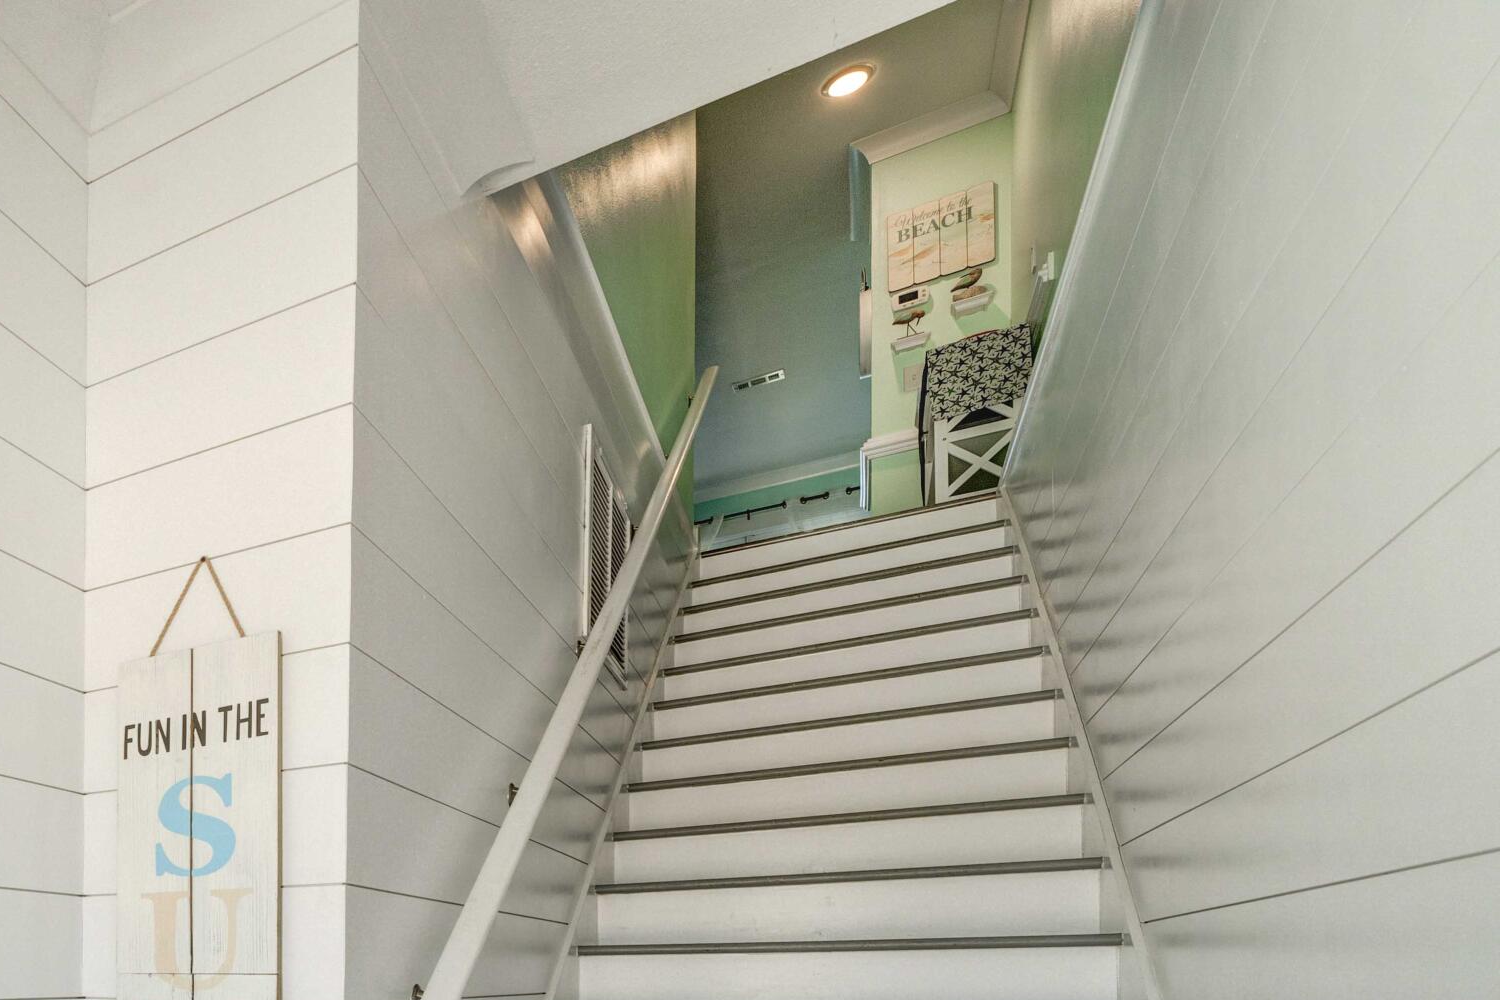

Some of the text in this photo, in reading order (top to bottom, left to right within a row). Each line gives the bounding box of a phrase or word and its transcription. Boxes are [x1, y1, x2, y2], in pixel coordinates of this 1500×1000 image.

[947, 200, 956, 212] to
[959, 194, 973, 209] the
[897, 205, 973, 243] BEACH
[123, 697, 269, 760] FUN IN THE
